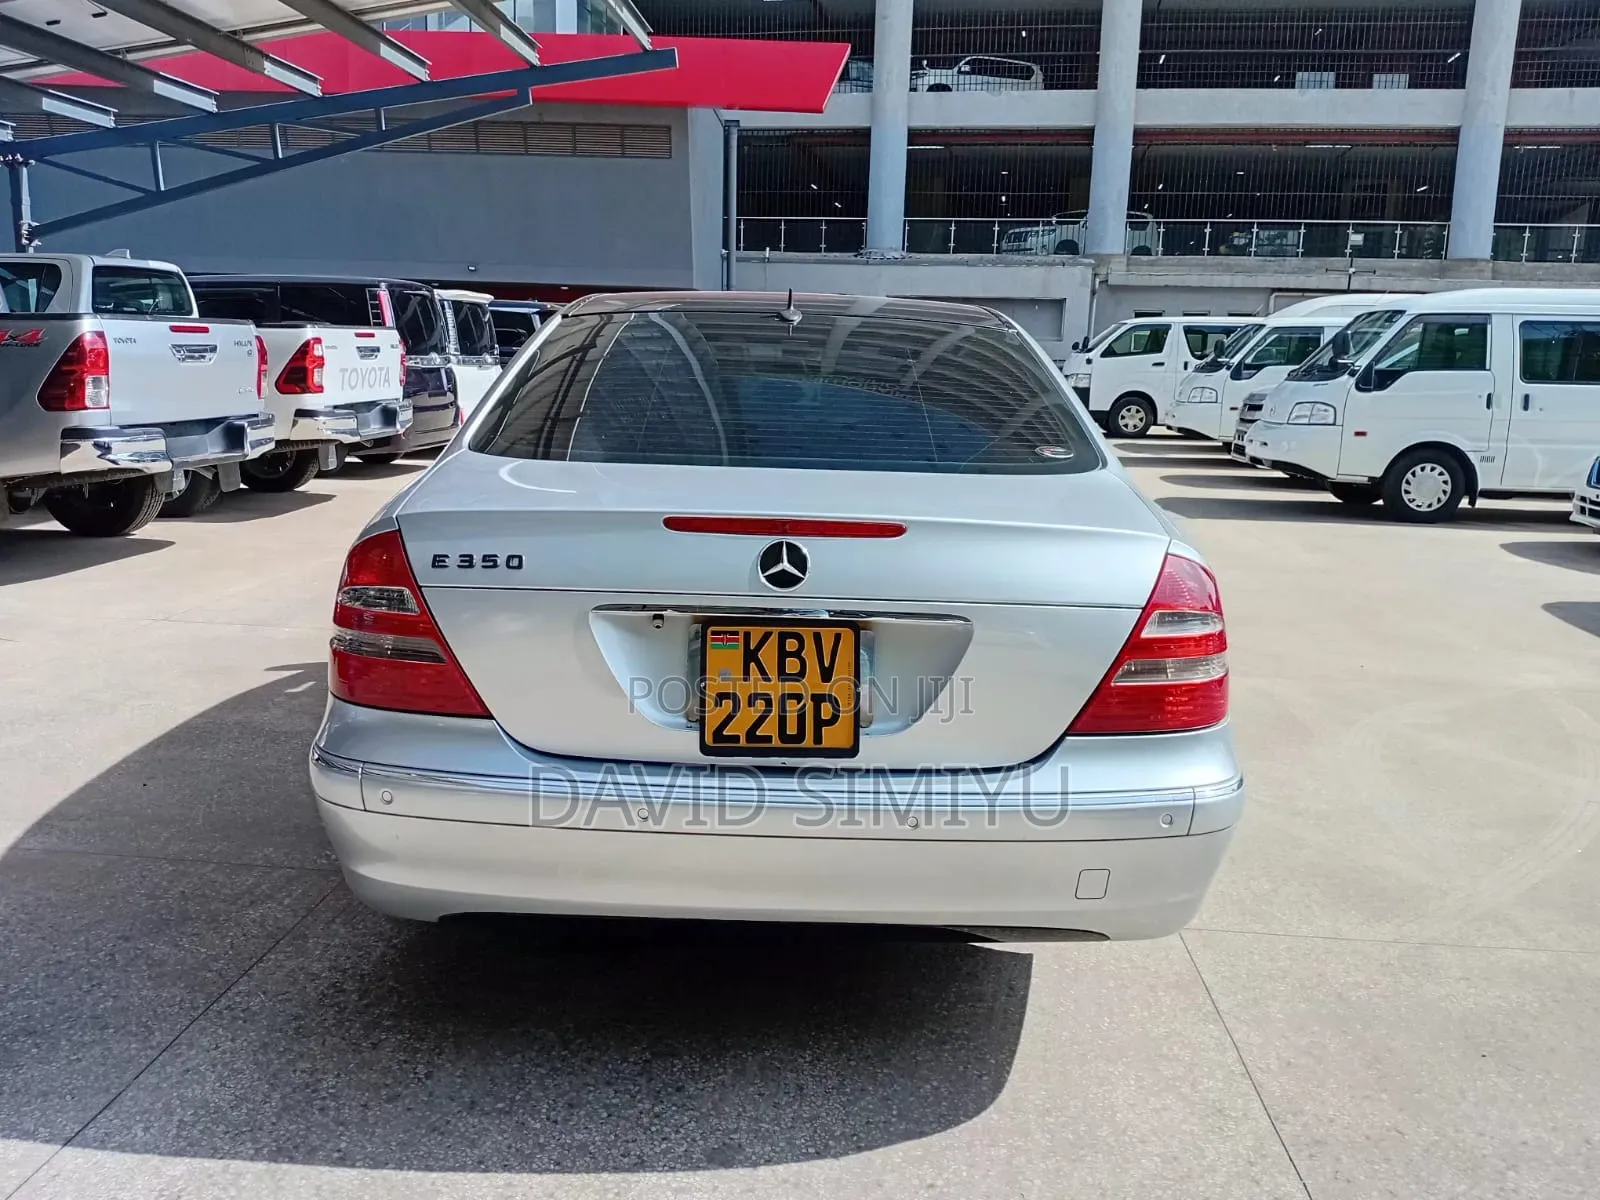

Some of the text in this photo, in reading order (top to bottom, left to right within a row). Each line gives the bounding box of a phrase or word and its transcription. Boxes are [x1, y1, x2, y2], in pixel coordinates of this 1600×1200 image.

[339, 367, 391, 390] TOYOTA
[743, 631, 842, 683] KBV
[712, 691, 841, 745] 220P
